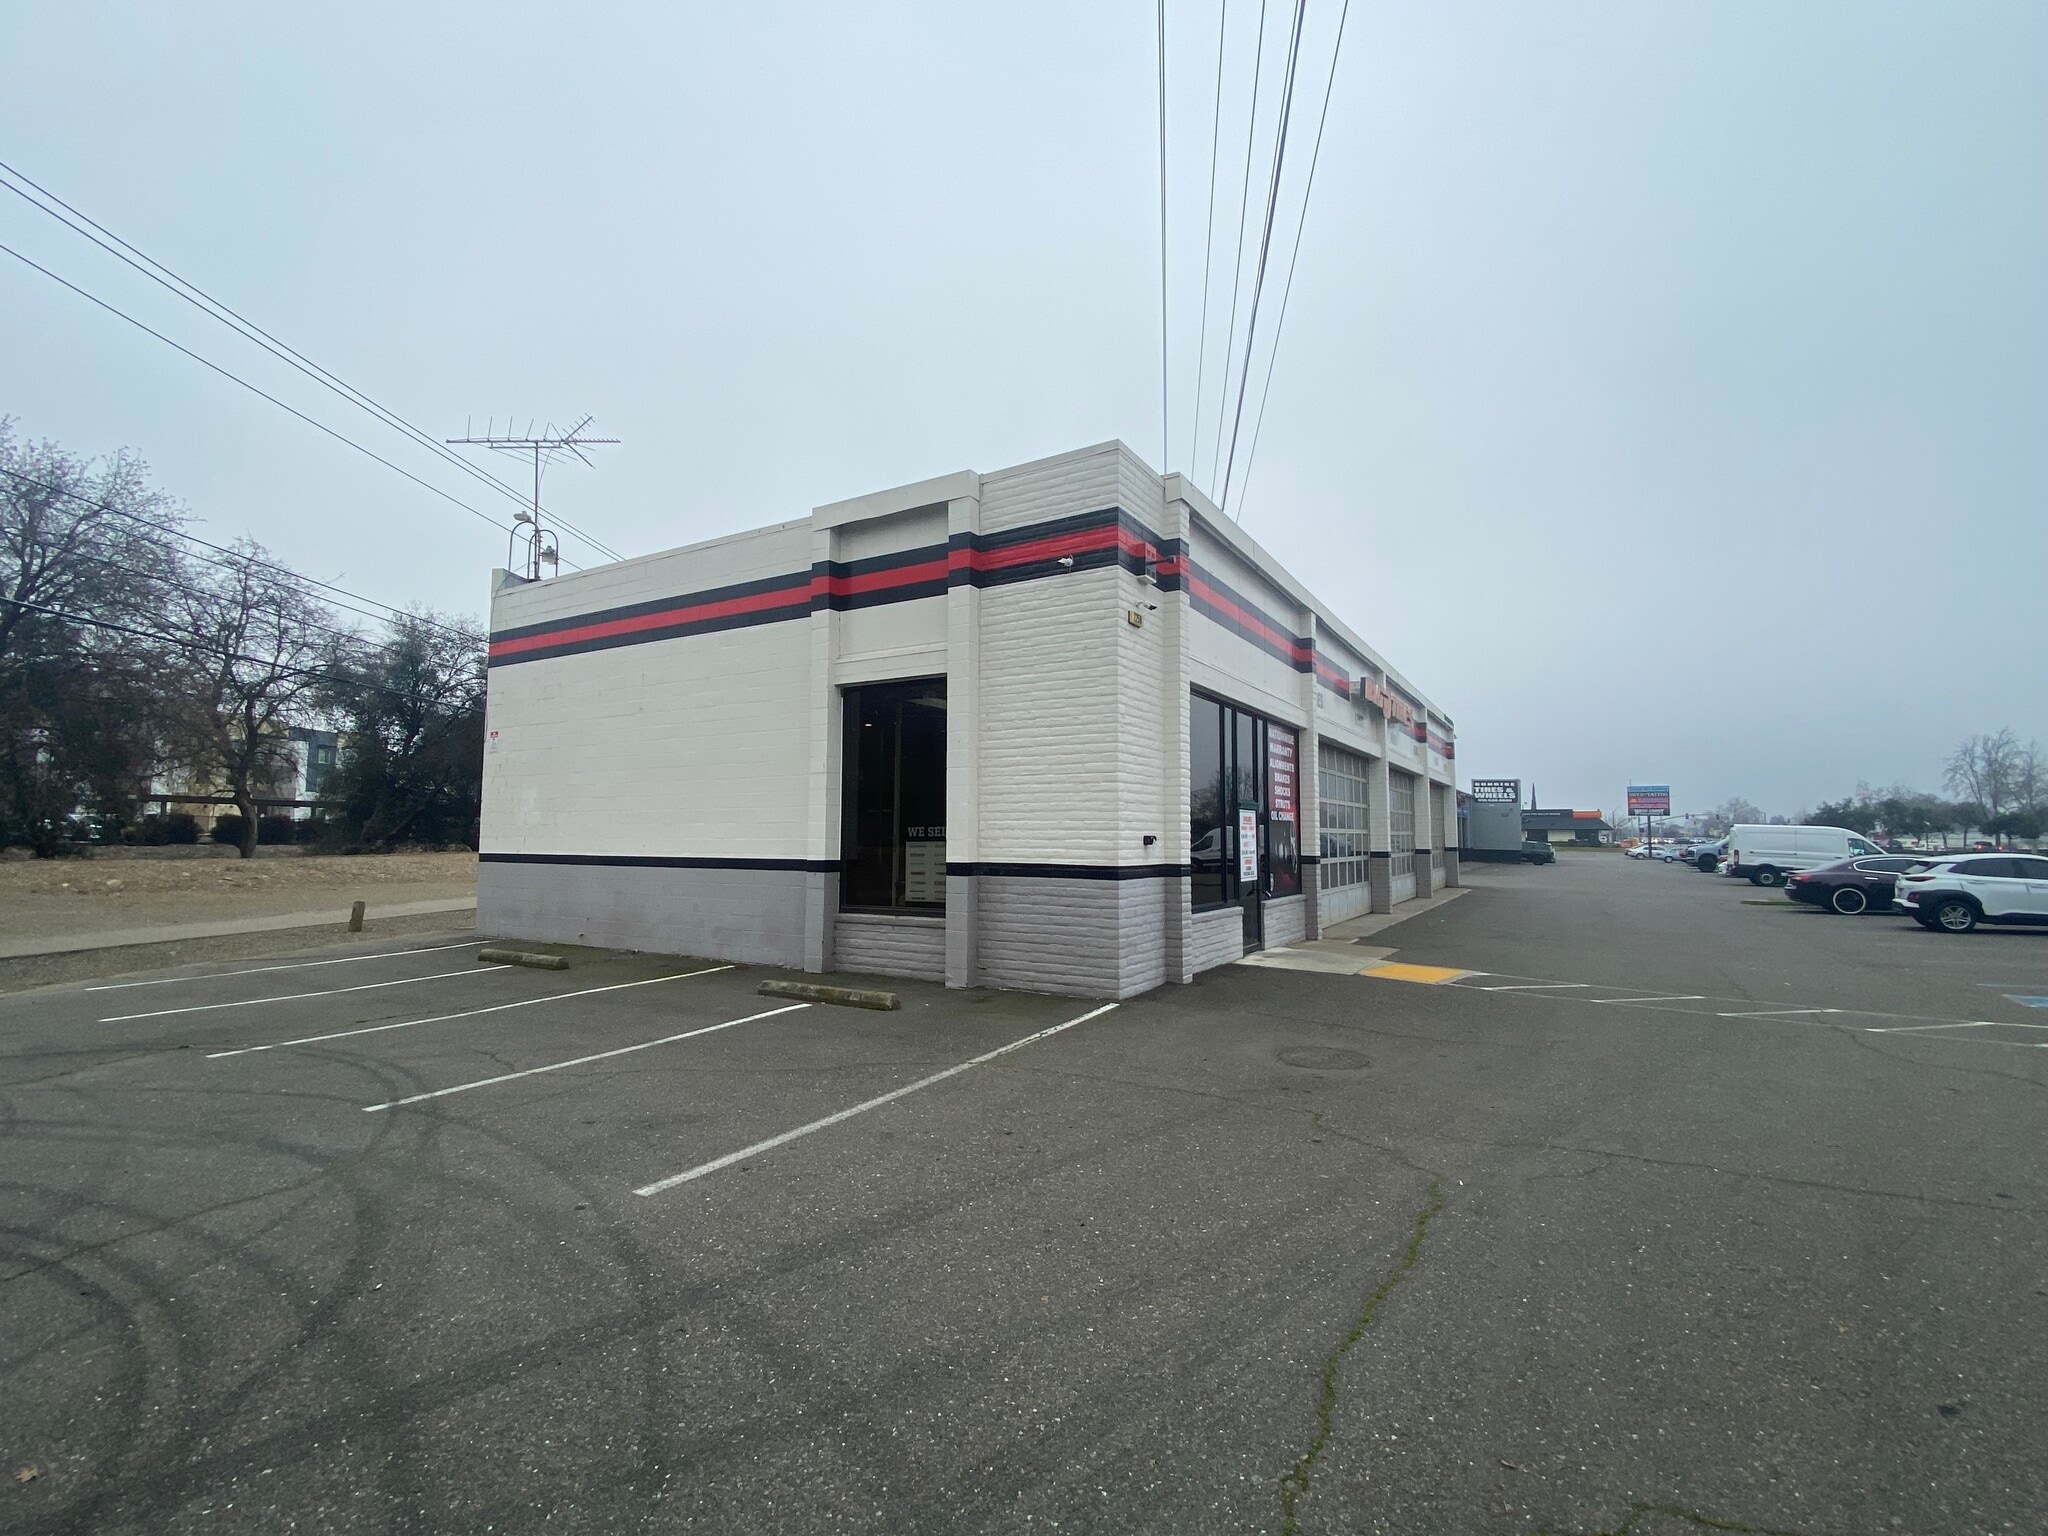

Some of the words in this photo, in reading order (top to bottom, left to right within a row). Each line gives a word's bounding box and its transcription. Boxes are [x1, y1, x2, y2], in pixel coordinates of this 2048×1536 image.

[1268, 727, 1294, 745] NATIONWIDE
[1269, 742, 1292, 758] WARRANTY
[1269, 757, 1295, 773] ALIGNMENTS
[1274, 772, 1290, 784] BRAKES
[1274, 785, 1291, 797] SHOCKS
[1275, 798, 1291, 810] STRUTS
[1270, 810, 1278, 821] OIL
[1278, 811, 1294, 821] CHANGE
[907, 826, 925, 837] WE
